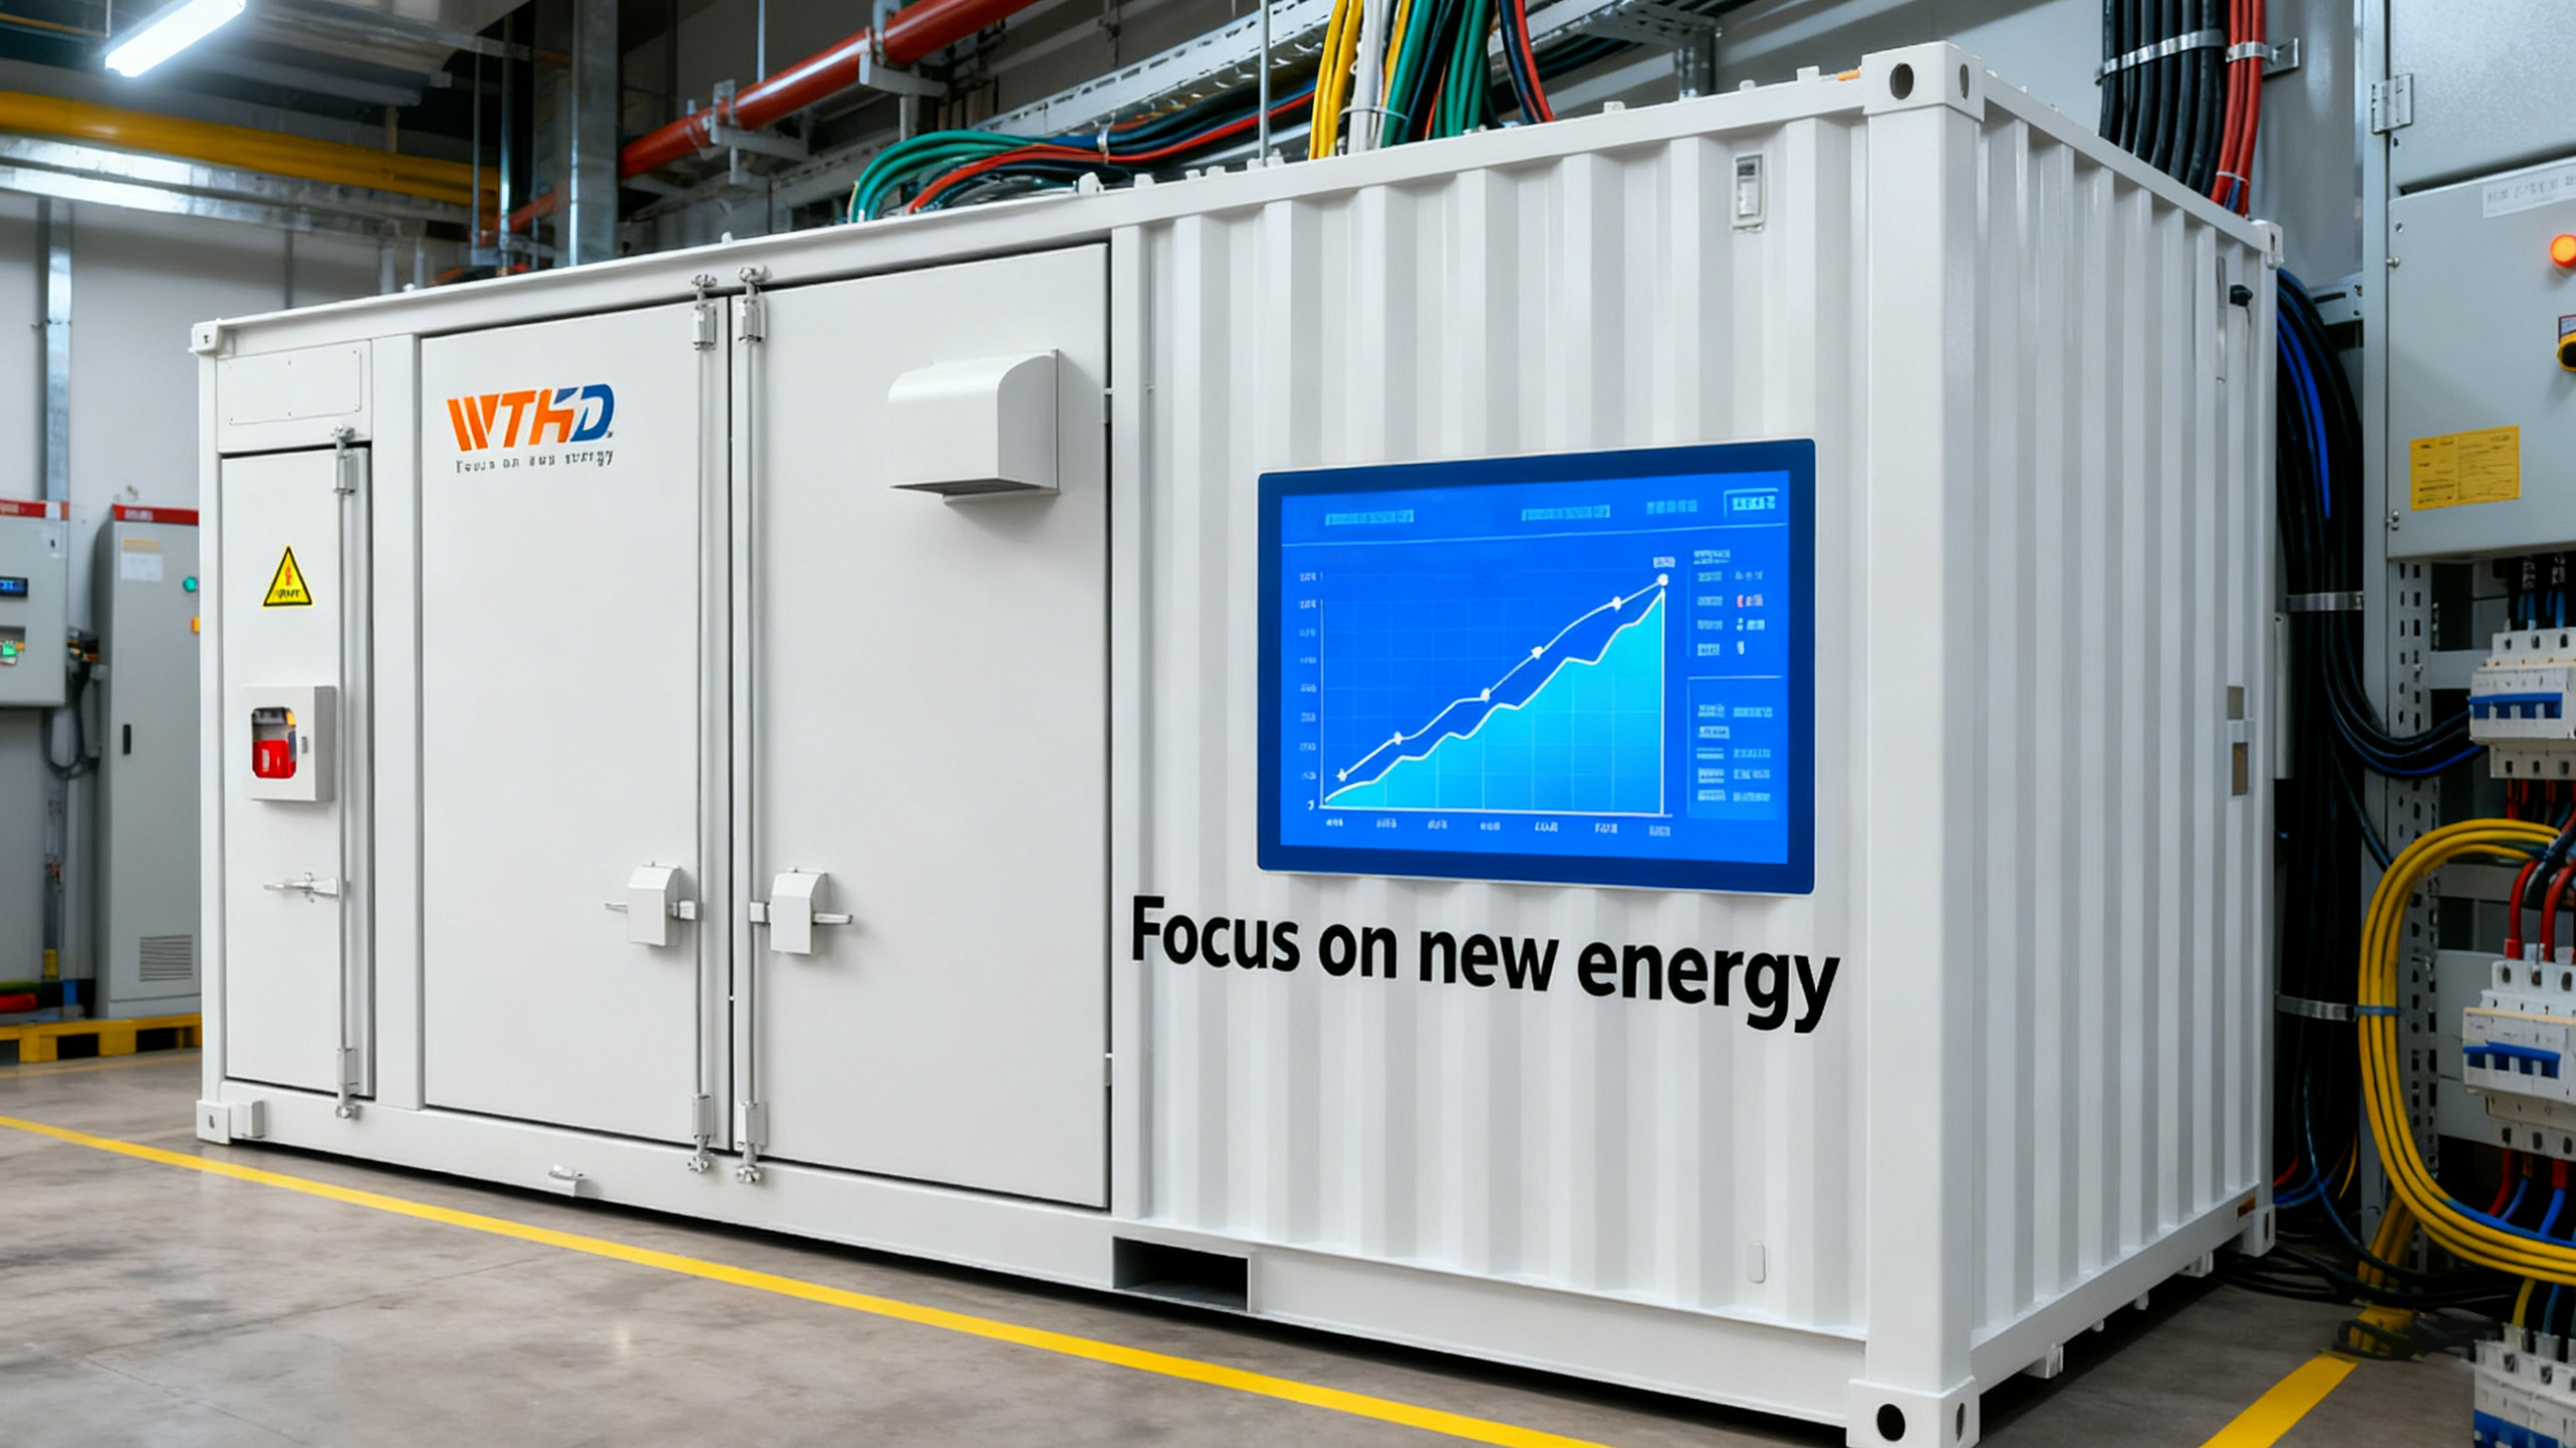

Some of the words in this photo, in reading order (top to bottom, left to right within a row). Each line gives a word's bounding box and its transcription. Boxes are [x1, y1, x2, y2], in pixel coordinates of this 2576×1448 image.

[1132, 895, 1301, 973] Focus
[1318, 924, 1397, 979] on
[1419, 931, 1560, 991] new
[1577, 941, 1841, 1034] energy
